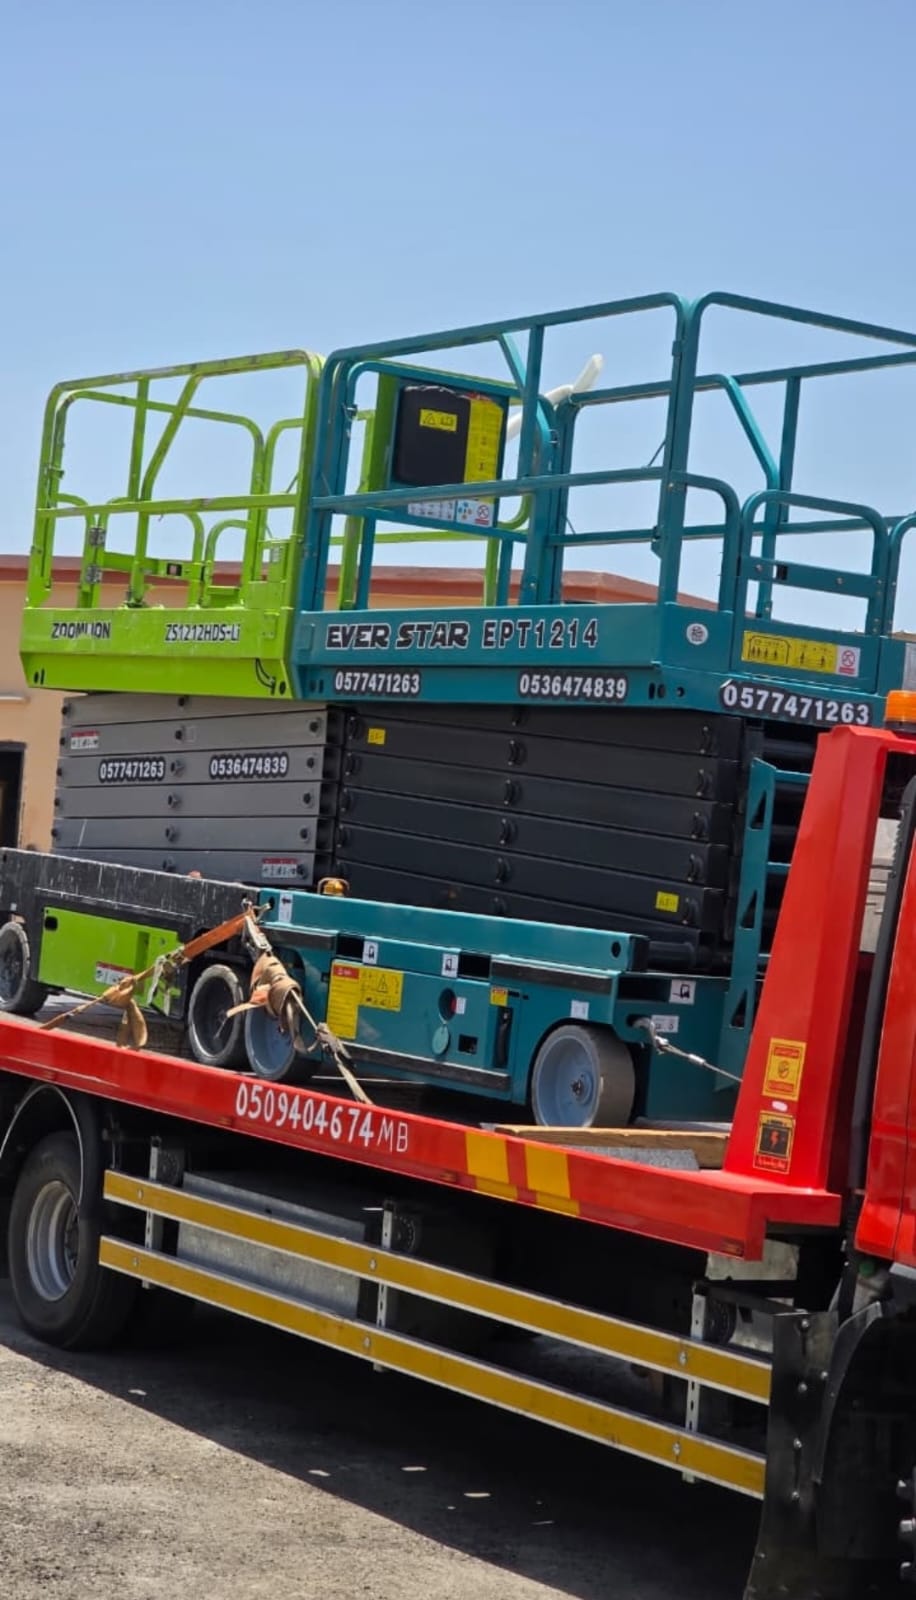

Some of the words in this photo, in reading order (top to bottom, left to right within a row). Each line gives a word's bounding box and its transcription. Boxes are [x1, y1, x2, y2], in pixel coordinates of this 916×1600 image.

[326, 622, 391, 650] EVER
[396, 620, 470, 649] STAR
[482, 618, 598, 648] EPT1214
[335, 671, 421, 694] 0577471263
[519, 673, 627, 699] 0536474839
[722, 683, 870, 725] 0577471263
[100, 759, 165, 780] 0577471263
[210, 755, 288, 777] 0536474839
[235, 1082, 374, 1148] 0509404674
